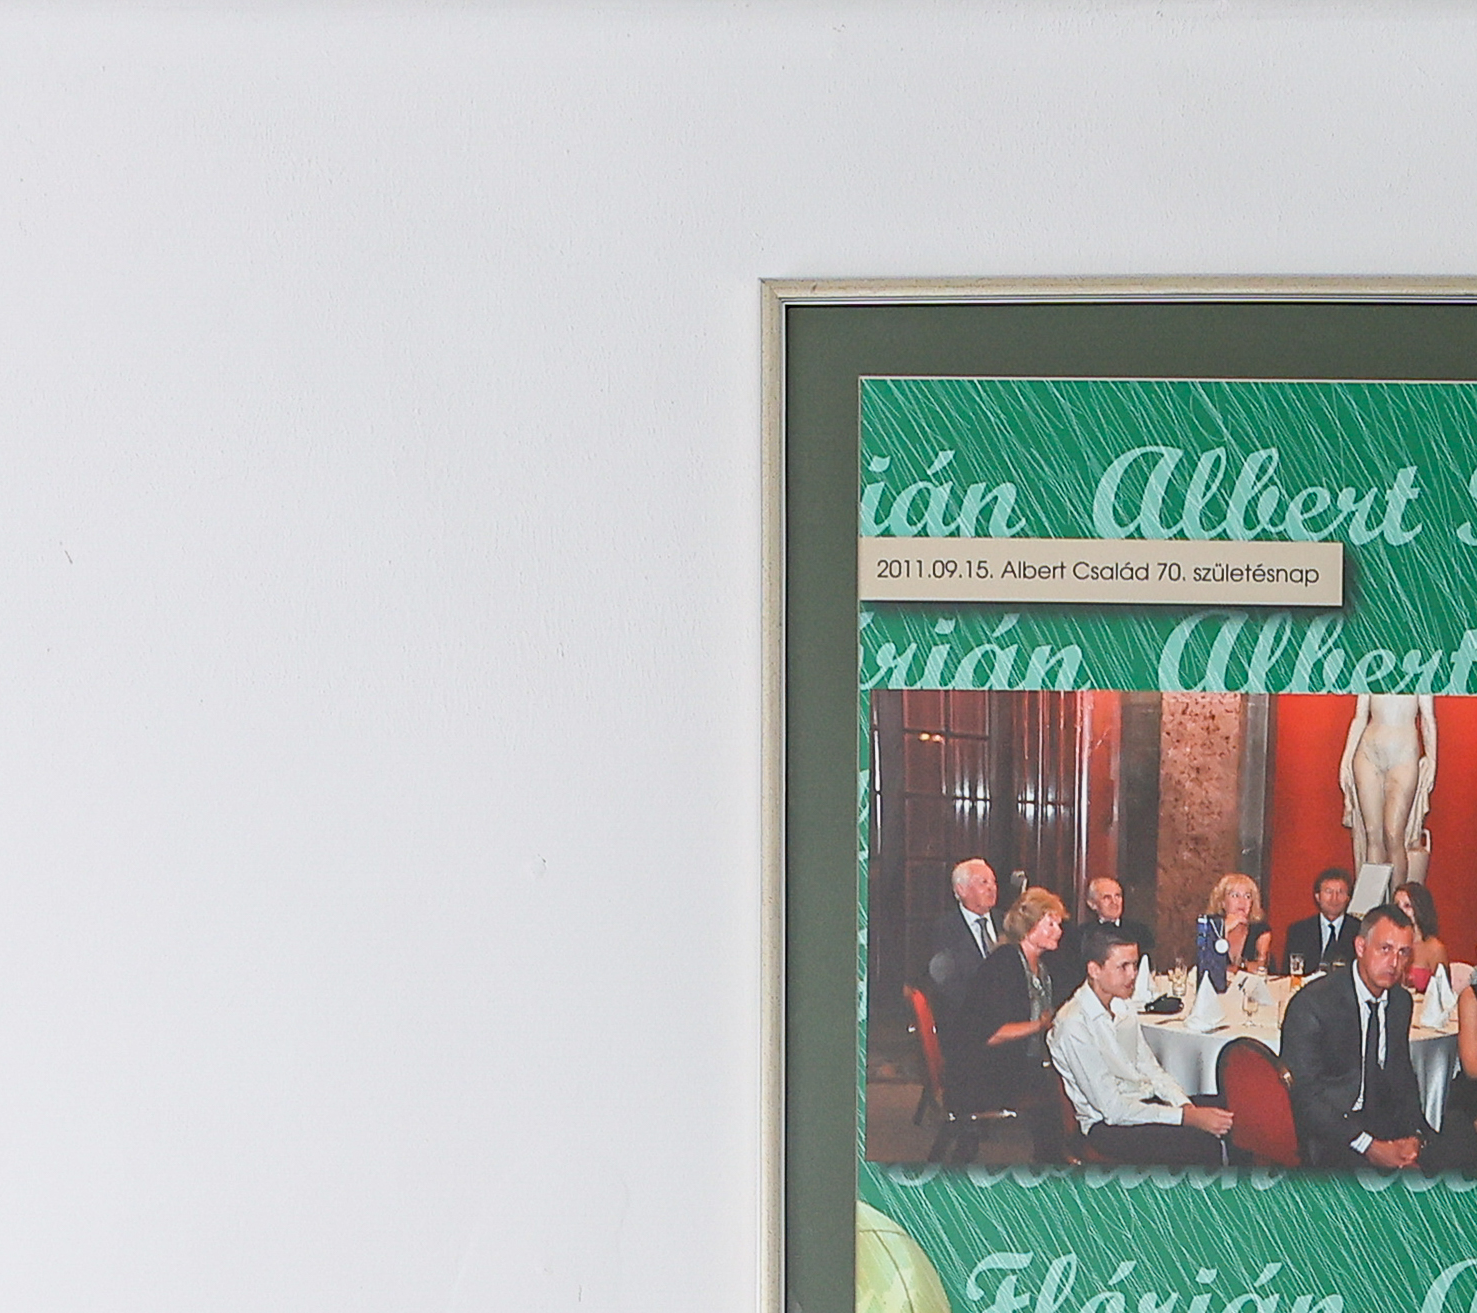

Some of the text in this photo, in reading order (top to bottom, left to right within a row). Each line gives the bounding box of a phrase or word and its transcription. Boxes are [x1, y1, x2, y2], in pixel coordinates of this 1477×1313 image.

[1092, 445, 1423, 545] Albert
[877, 559, 1319, 587] 2011.09.15. Albert Család 70. születésnap
